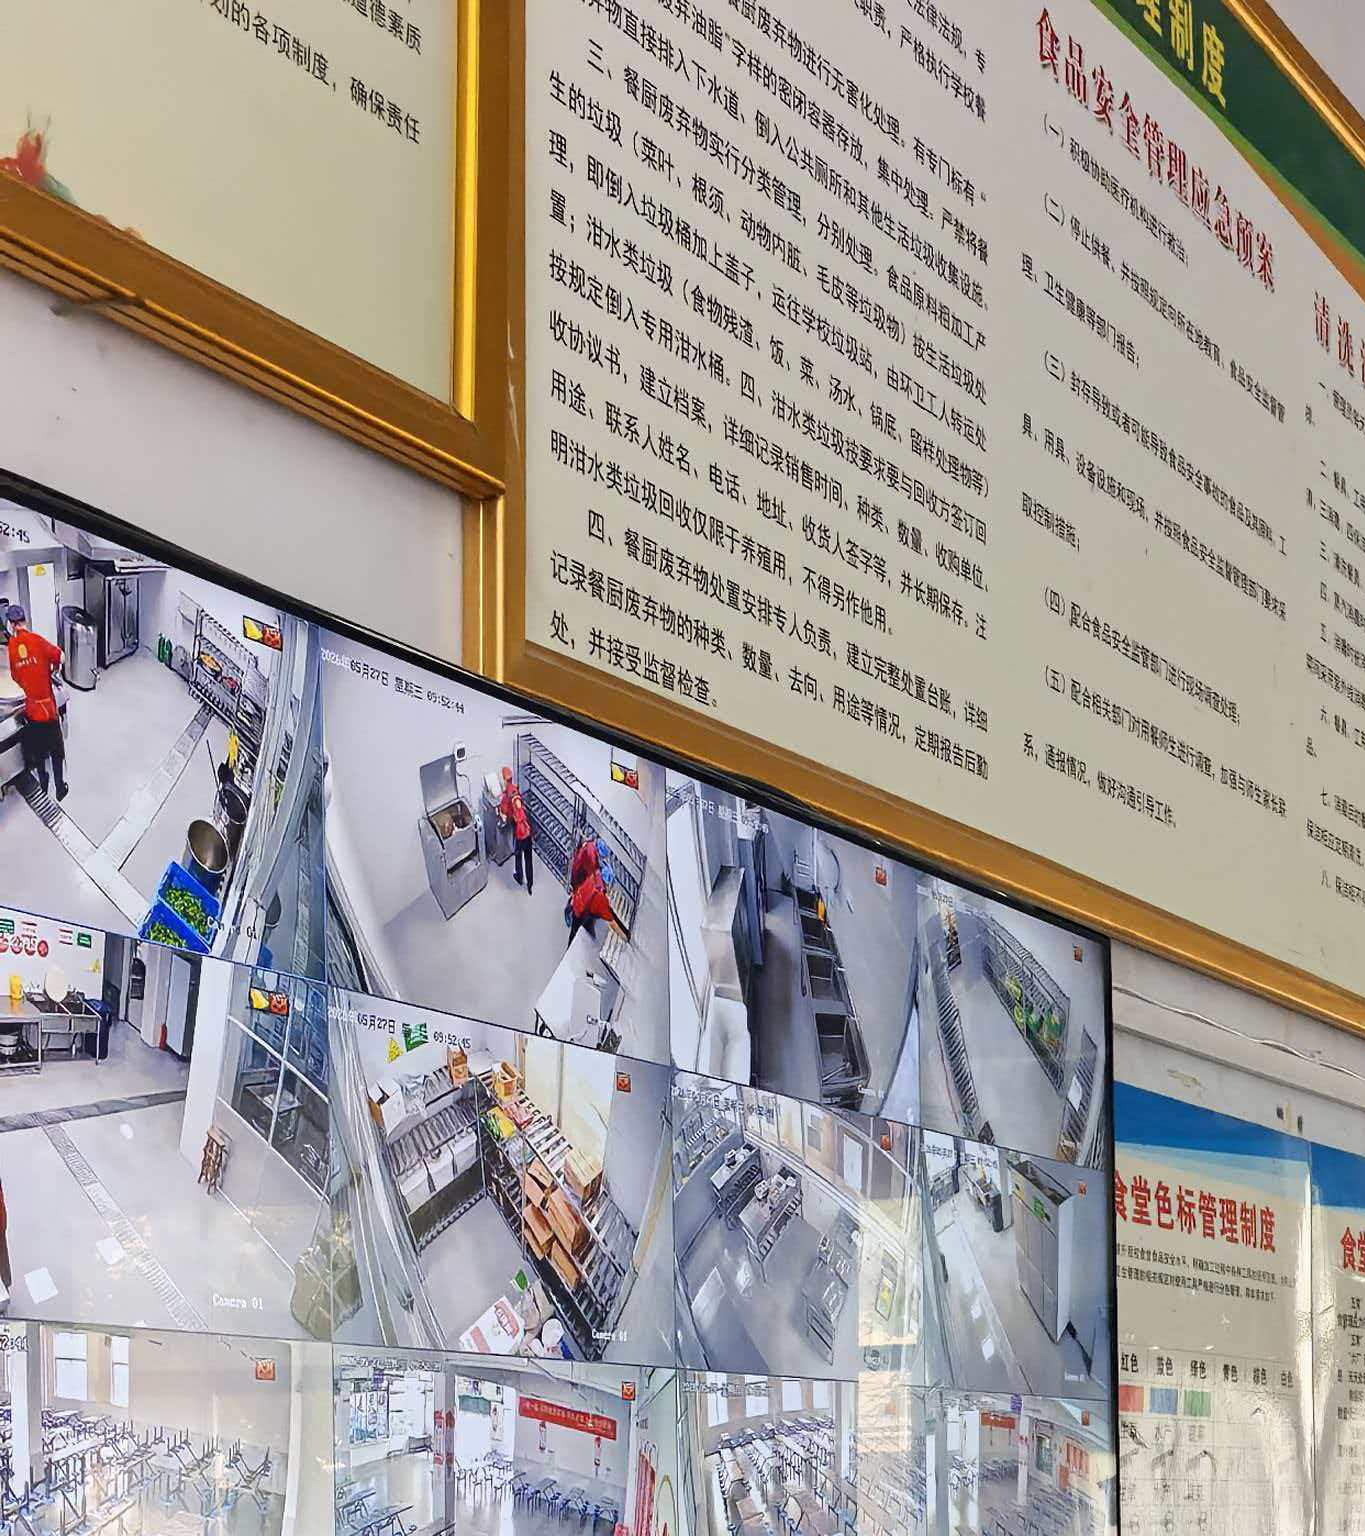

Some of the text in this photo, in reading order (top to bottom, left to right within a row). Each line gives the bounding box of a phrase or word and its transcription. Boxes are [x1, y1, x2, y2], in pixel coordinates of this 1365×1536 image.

[1036, 8, 1276, 293] 食品安全管理应急预案
